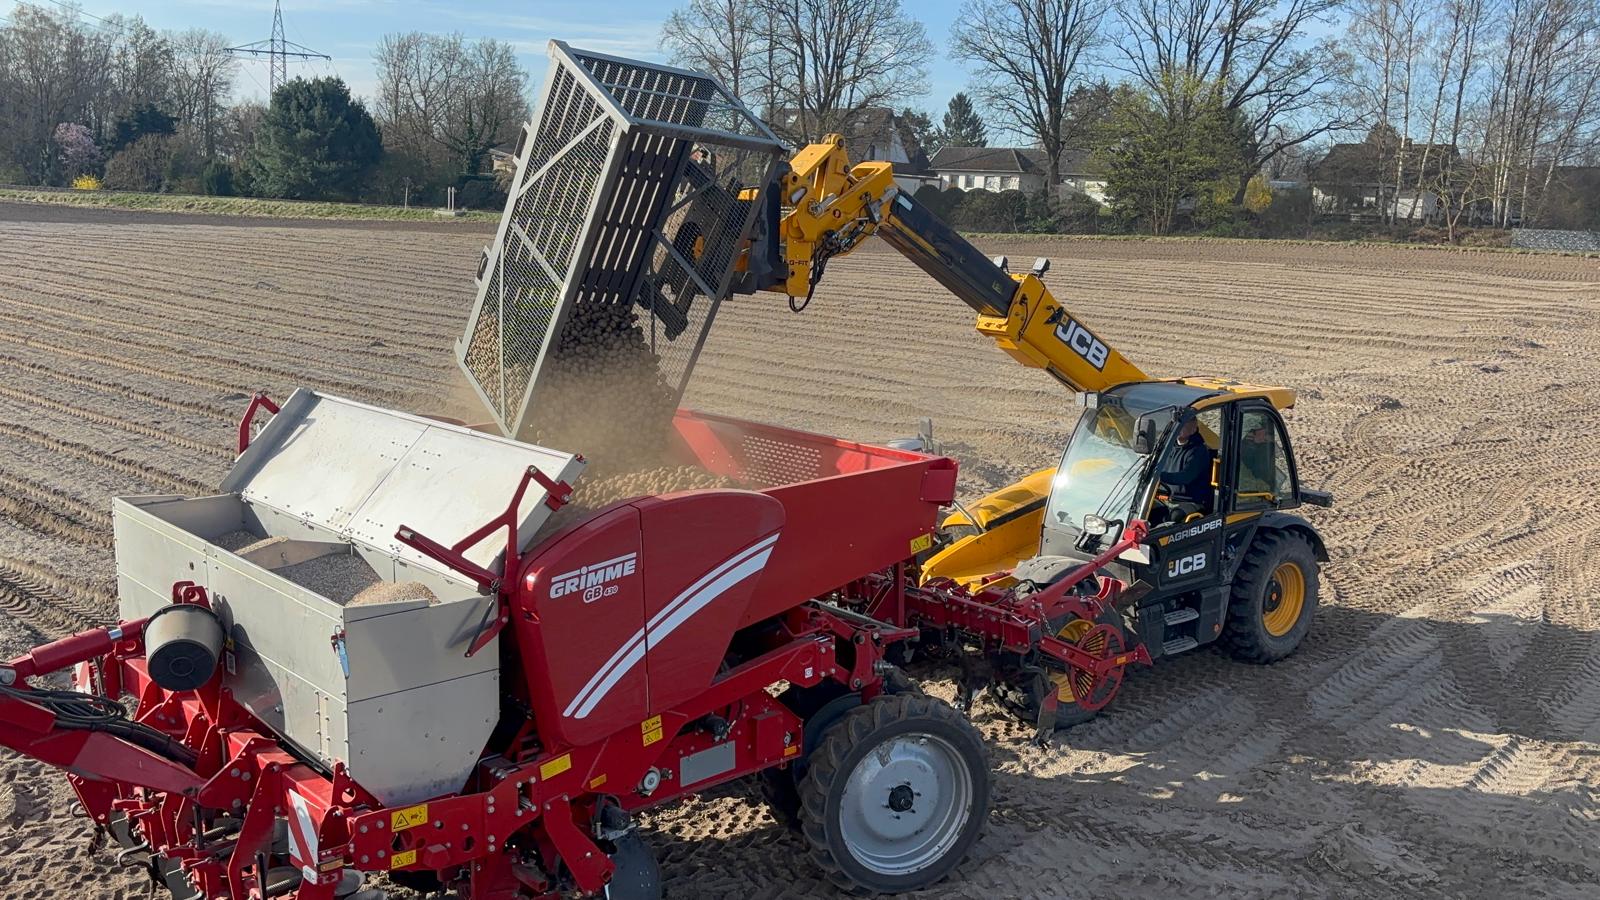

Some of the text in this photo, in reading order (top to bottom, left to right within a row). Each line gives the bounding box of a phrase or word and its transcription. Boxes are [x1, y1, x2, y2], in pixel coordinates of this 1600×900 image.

[1056, 321, 1108, 369] JCB
[550, 558, 637, 599] GRIMME
[1168, 552, 1206, 578] JCB
[583, 585, 618, 602] GB 430
